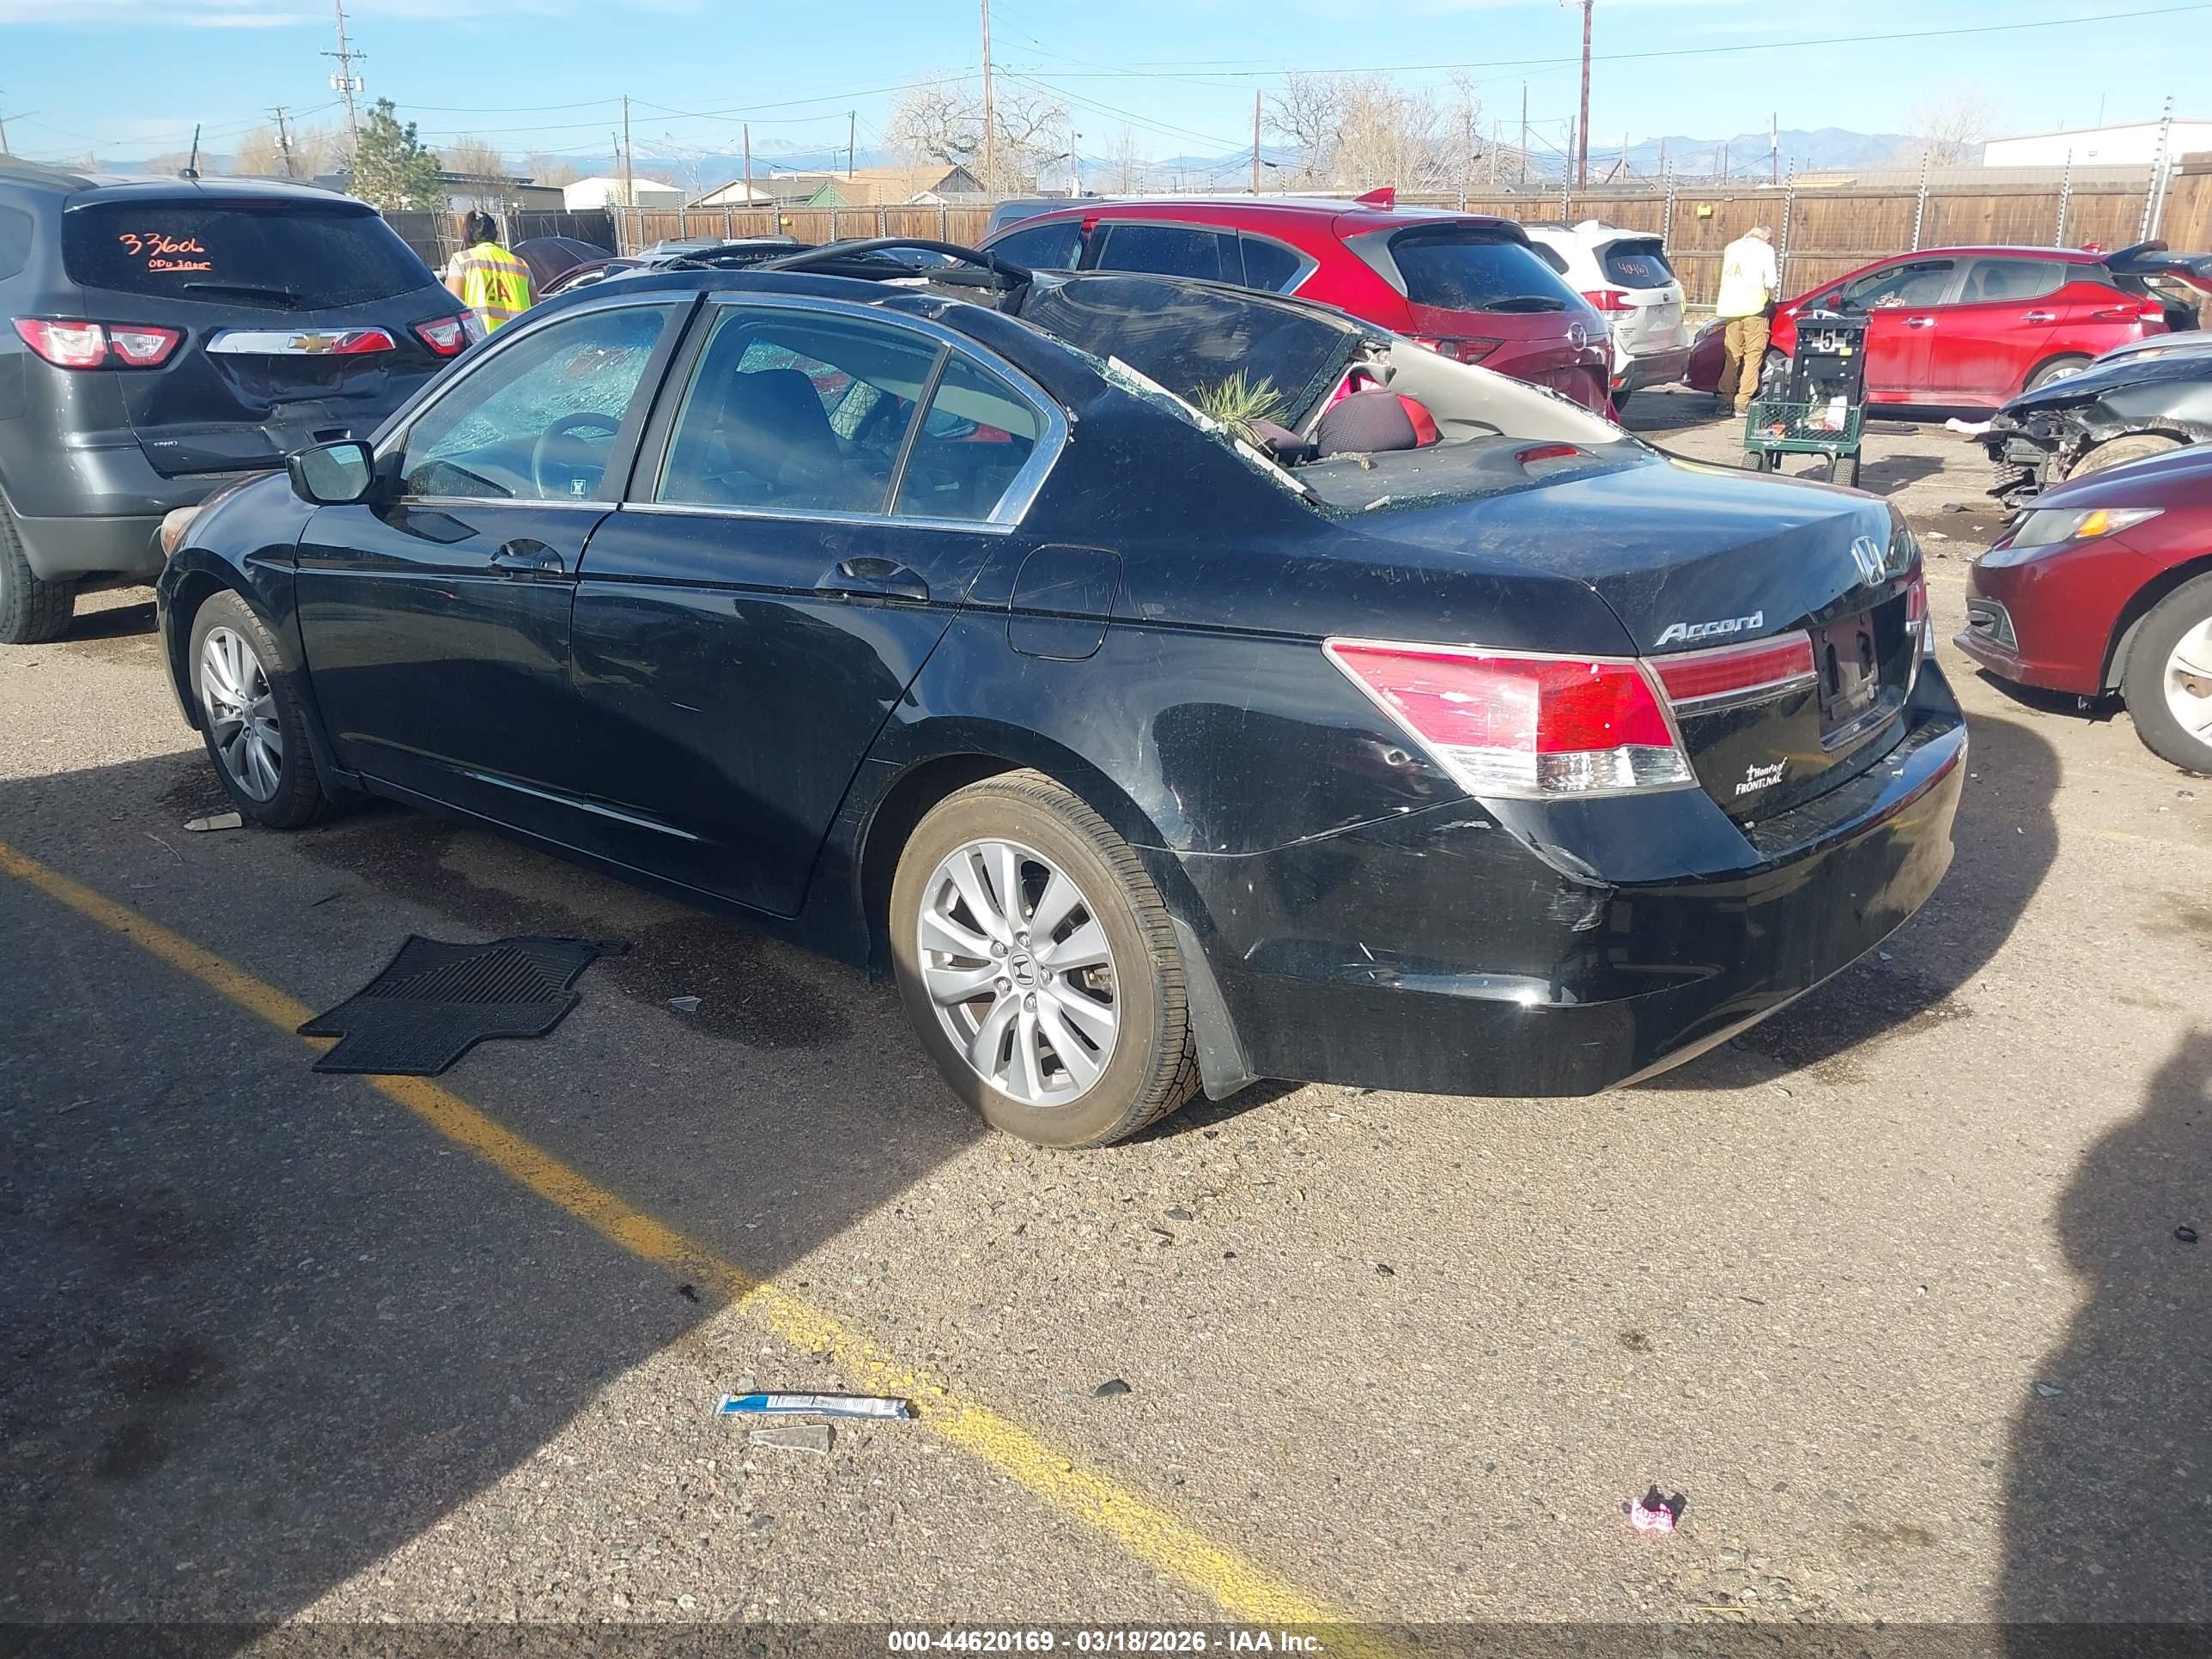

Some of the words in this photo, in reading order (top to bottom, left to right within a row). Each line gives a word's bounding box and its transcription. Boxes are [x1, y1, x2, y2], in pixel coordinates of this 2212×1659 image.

[1653, 611, 1764, 647] Accord
[1753, 763, 1778, 778] Honda
[1735, 773, 1783, 796] FRONTENAC
